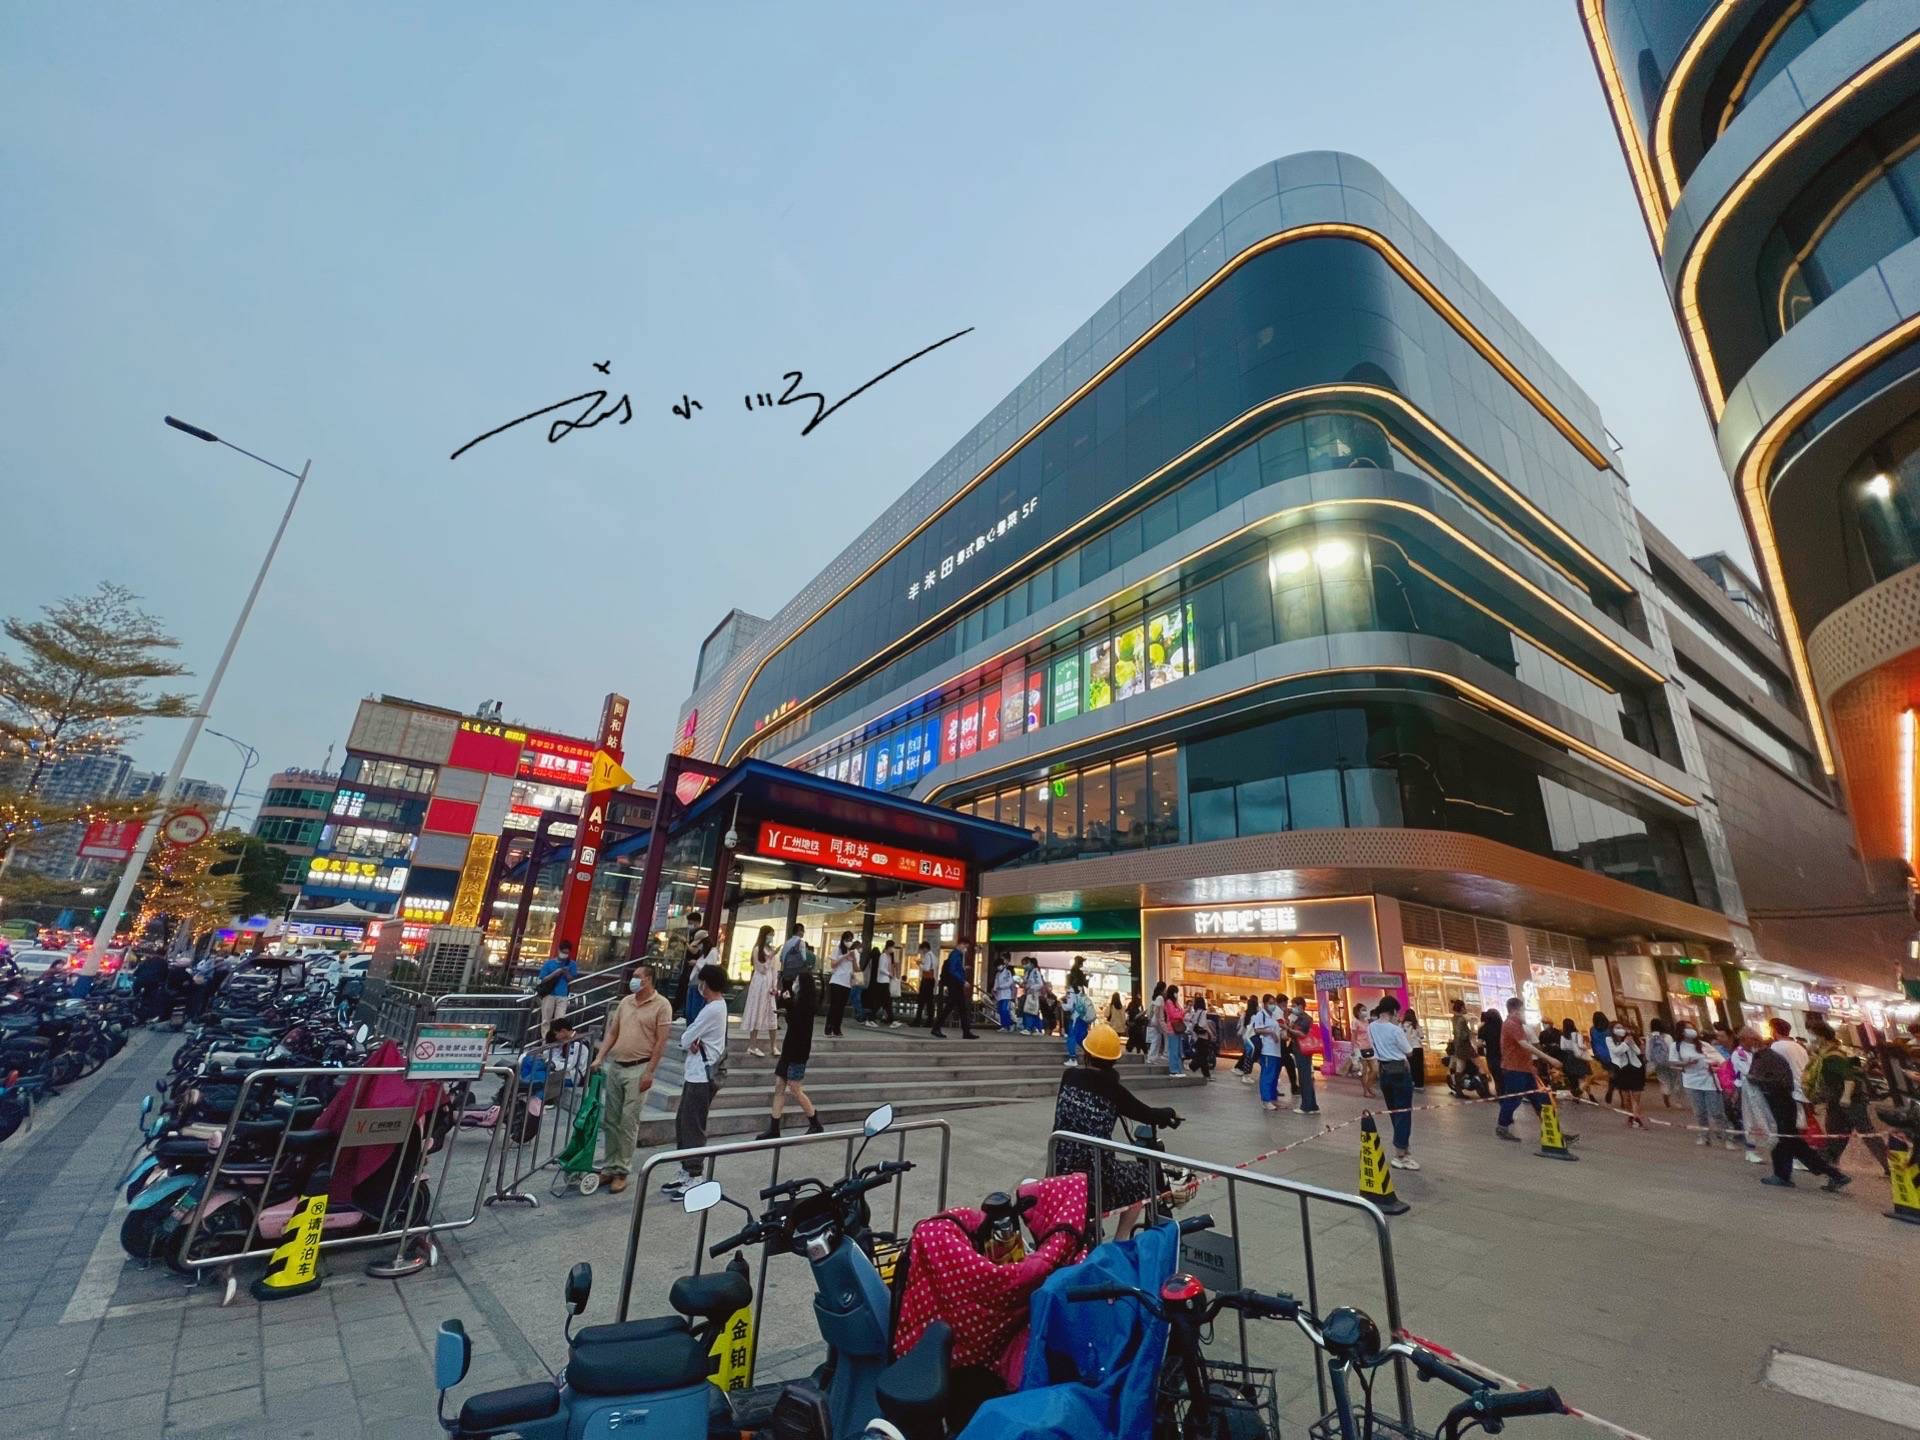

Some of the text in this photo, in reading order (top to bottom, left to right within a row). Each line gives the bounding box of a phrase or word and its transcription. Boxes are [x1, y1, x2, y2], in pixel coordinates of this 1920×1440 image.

[606, 702, 625, 749] 同和站
[589, 805, 602, 824] A
[782, 835, 820, 851] 广州地铁
[830, 838, 869, 859] 同和站
[836, 855, 862, 868] Tonghe
[932, 863, 943, 878] A
[945, 865, 960, 876] 入口
[297, 1218, 322, 1276] 请勿泊车
